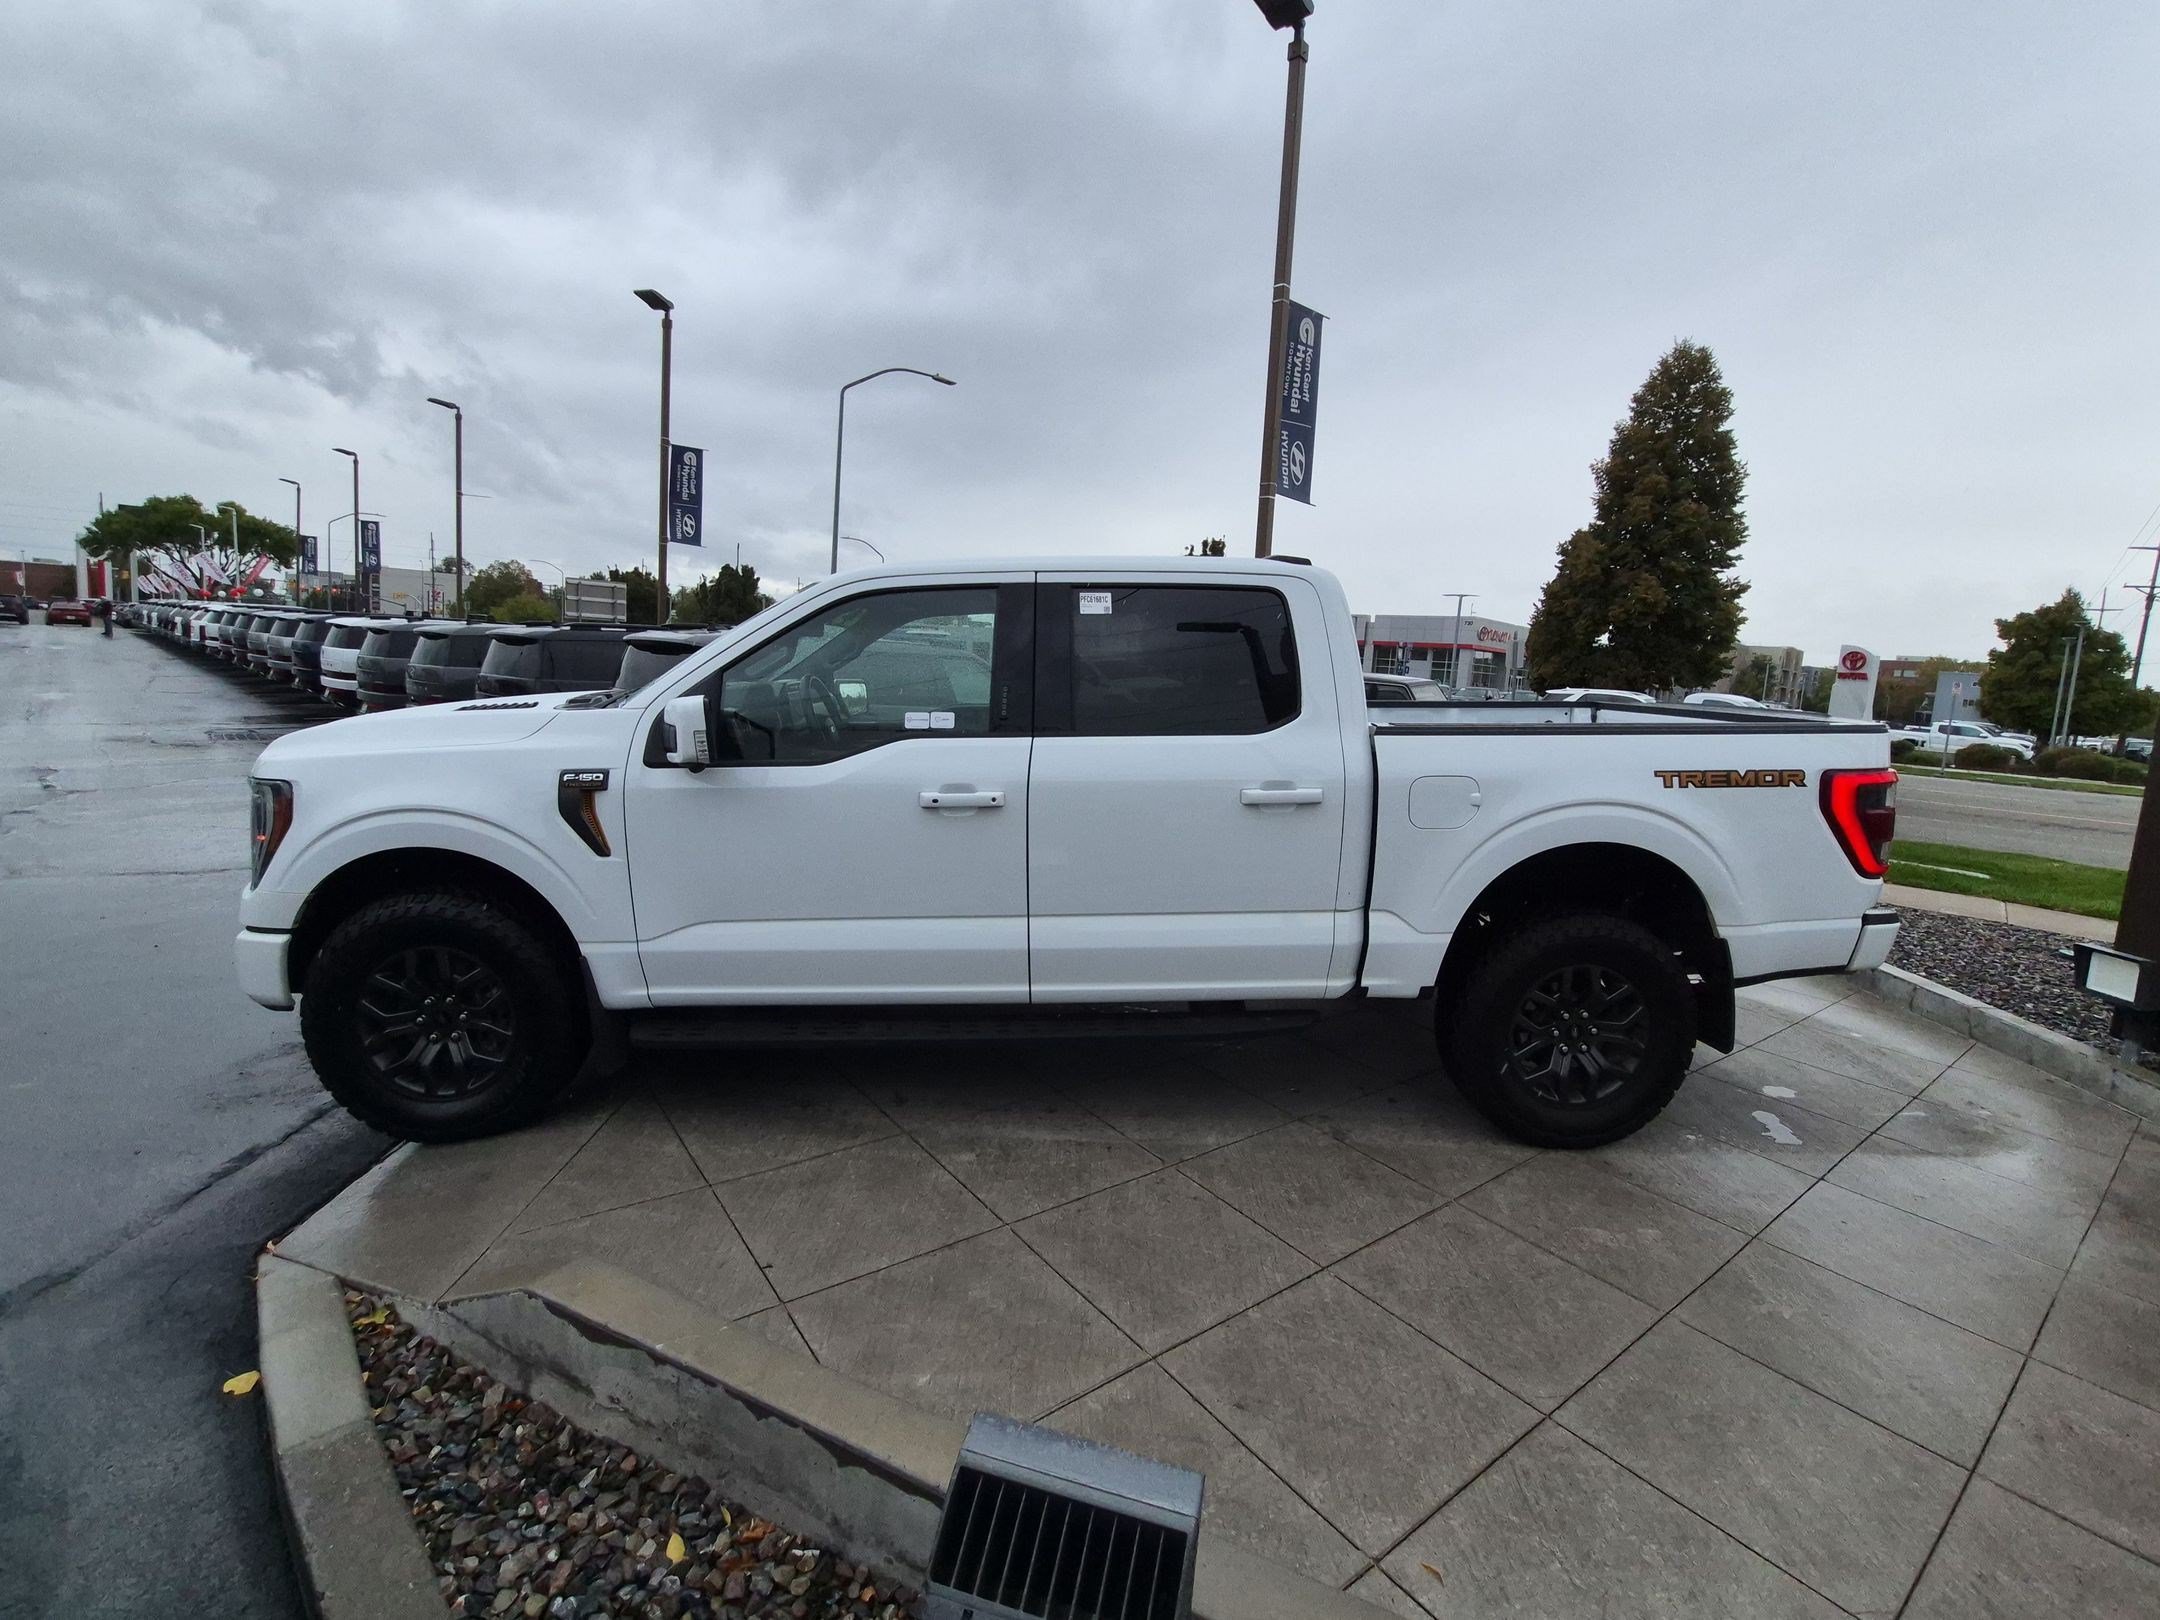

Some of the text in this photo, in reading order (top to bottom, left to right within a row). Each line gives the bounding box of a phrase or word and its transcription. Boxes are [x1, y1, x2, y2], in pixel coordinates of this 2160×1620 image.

[1283, 342, 1294, 396] DOWNTOWN
[1290, 344, 1305, 414] Hyundai
[1302, 347, 1313, 402] Ken Garff
[681, 465, 689, 501] Hyundai
[1281, 430, 1289, 489] HYUNDAI
[563, 773, 604, 781] F-150
[1654, 769, 1808, 788] TREMOR
